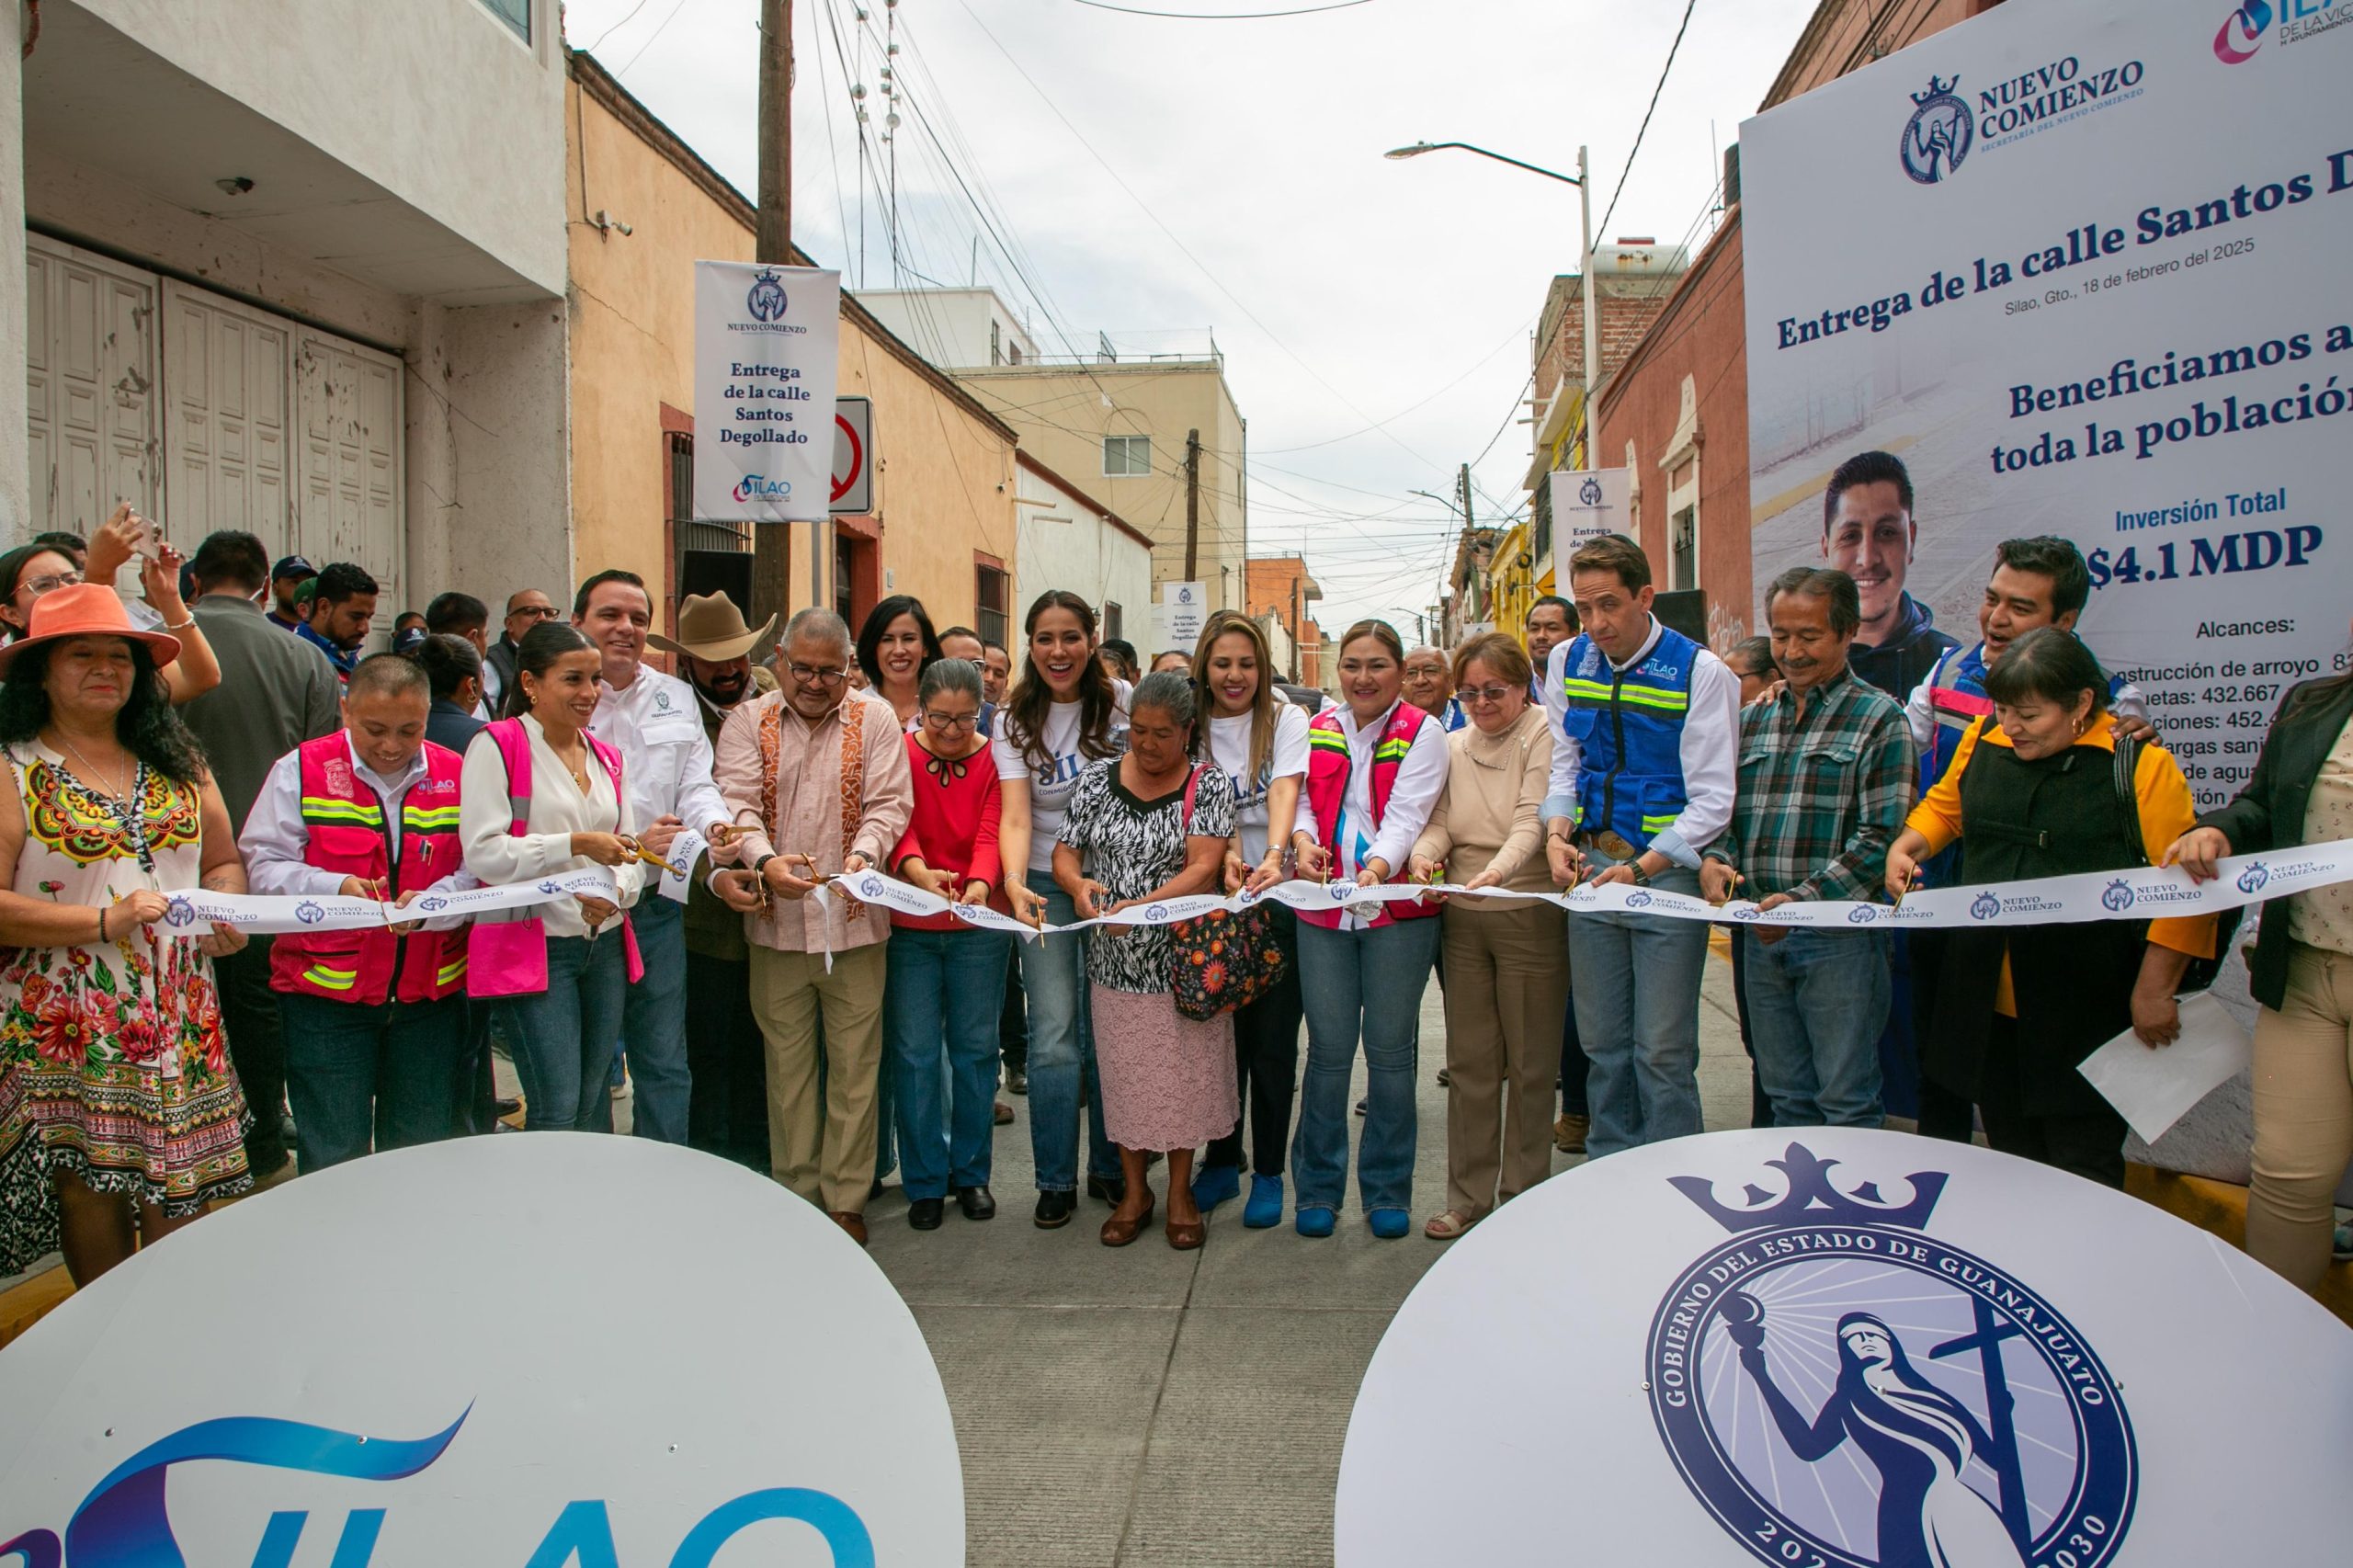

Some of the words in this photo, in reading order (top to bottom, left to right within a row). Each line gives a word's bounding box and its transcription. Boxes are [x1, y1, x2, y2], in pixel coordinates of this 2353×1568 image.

[2280, 22, 2300, 39] DE
[2304, 16, 2322, 30] LA
[2325, 2, 2353, 21] VIC
[1979, 56, 2079, 114] NUEVO
[1981, 61, 2144, 139] COMIENZO
[2038, 121, 2055, 134] DEL
[2057, 108, 2089, 125] NUEVO
[2090, 88, 2144, 113] COMIENZO
[1777, 292, 1912, 349] Entrega
[1920, 271, 1965, 309] de
[1973, 257, 2011, 293] la
[2021, 223, 2125, 278] calle
[2135, 173, 2313, 245] Santos
[2005, 293, 2042, 316] Silao,
[2045, 285, 2078, 308] Gto.,
[2083, 278, 2100, 295] 18
[2103, 271, 2121, 290] de
[2125, 258, 2179, 285] febrero
[2185, 250, 2209, 269] del
[2213, 238, 2256, 263] 2025
[727, 323, 758, 332] NUEVO
[758, 324, 808, 334] COMIENZO
[731, 363, 801, 381] Entrega
[2009, 329, 2312, 418] Beneficiamos
[2325, 324, 2353, 353] a
[724, 385, 745, 399] de
[748, 385, 764, 398] la
[767, 386, 811, 401] calle
[735, 407, 793, 422] Santos
[1991, 433, 2076, 473] toda
[2086, 423, 2124, 458] la
[2136, 376, 2353, 460] població
[720, 429, 808, 447] Degollado
[2116, 499, 2217, 532] Inversión
[2225, 487, 2286, 517] Total
[1573, 528, 1612, 537] Entrega
[1570, 540, 1582, 548] de
[2087, 542, 2179, 589] $4.1
[2189, 525, 2323, 576] MDP
[2196, 619, 2295, 639] Alcances:
[2221, 661, 2246, 677] de
[2252, 657, 2320, 678] arroyo
[2334, 653, 2353, 671] 8
[2201, 685, 2279, 705] 432.667
[2183, 764, 2207, 780] de
[2213, 766, 2257, 784] agu
[2269, 863, 2336, 881] COMIENZO
[2272, 861, 2314, 874] NUEVO
[564, 876, 597, 888] NUEVO
[567, 881, 613, 891] OMIENZO
[2136, 883, 2178, 894] NUEVO
[884, 891, 928, 910] COMIENZO
[886, 886, 915, 900] NUEVO
[1655, 897, 1686, 906] NUEVO
[2003, 895, 2040, 906] NUEVO
[2137, 890, 2202, 903] COMIENZO
[198, 904, 235, 915] NUEVO
[1169, 901, 1198, 911] NUEVO
[1169, 903, 1214, 915] COMIENZO
[1652, 901, 1701, 913] COMIENZO
[2002, 902, 2063, 914] COMIENZO
[198, 913, 258, 922] COMIENZO
[1665, 1282, 1712, 1408] GOBIERNO
[1709, 1250, 1758, 1285] DEL
[1765, 1233, 1878, 1260] ESTADO
[1889, 1240, 1929, 1263] DE
[1939, 1256, 2105, 1406] GUANAJUATO
[2042, 1515, 2107, 1568] 030
